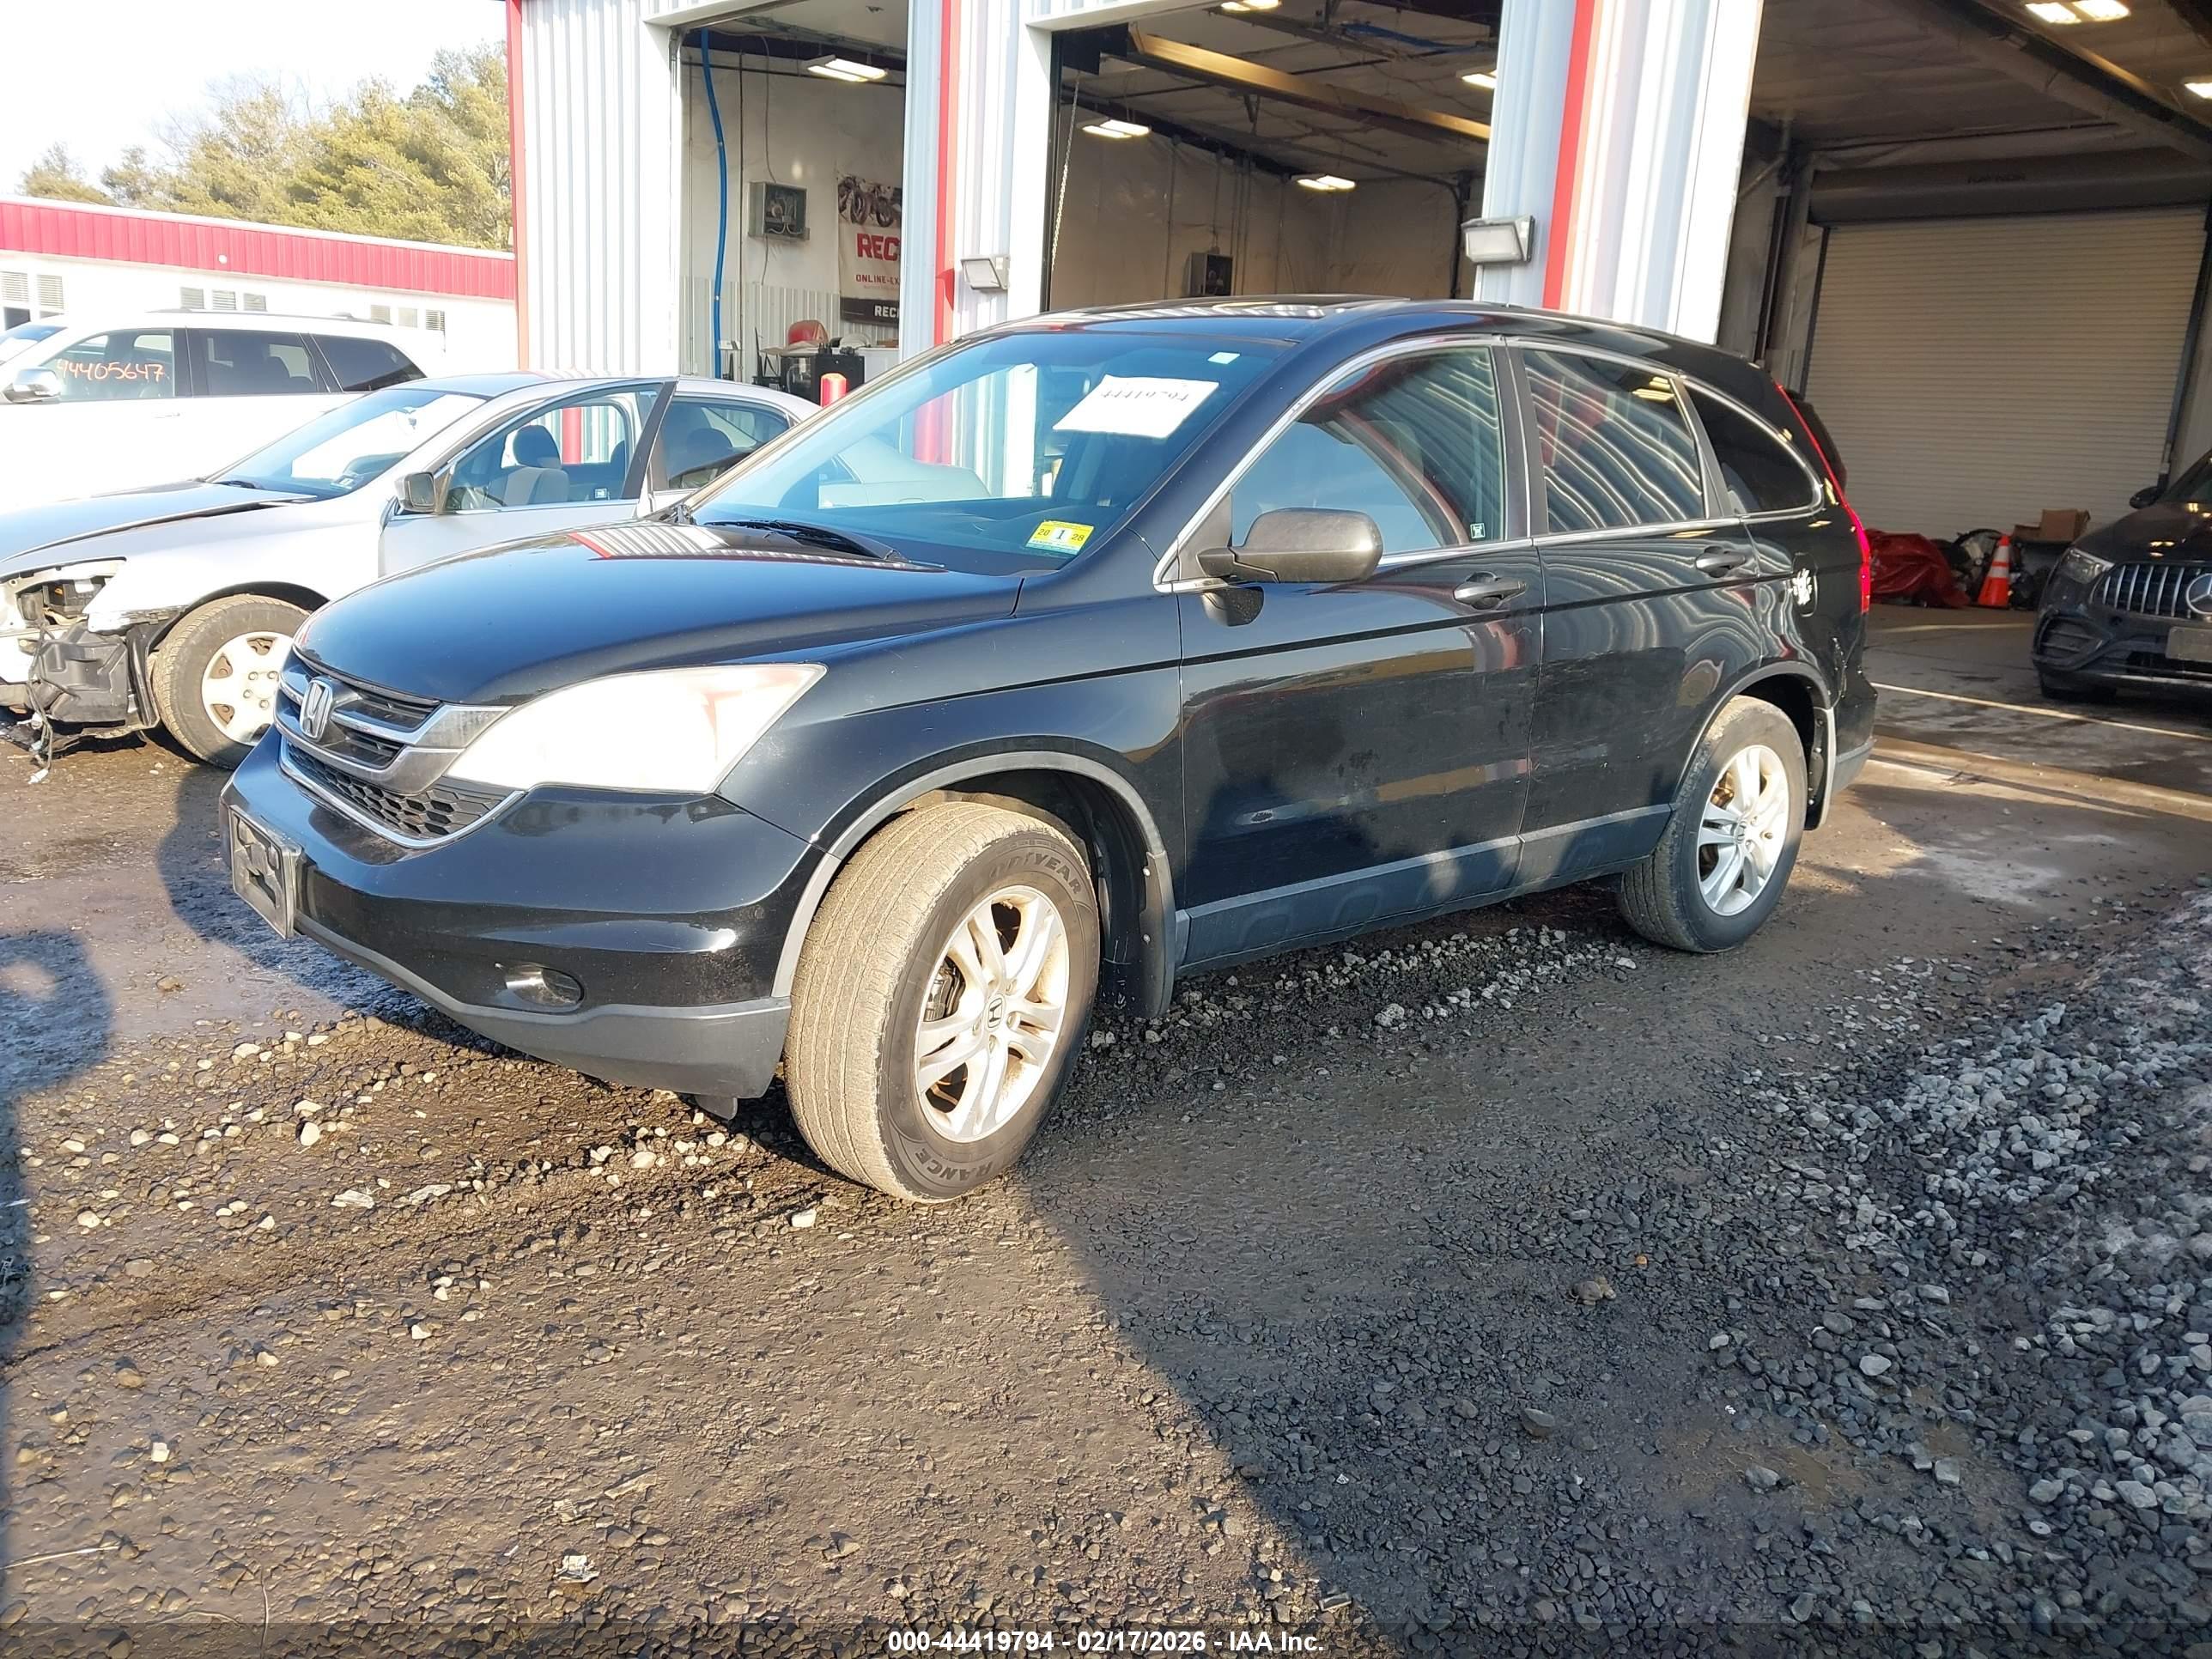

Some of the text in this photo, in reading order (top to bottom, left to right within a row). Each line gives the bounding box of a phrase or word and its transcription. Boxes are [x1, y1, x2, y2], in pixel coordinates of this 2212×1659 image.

[874, 305, 899, 319] REC
[1037, 528, 1085, 542] 20 1 28
